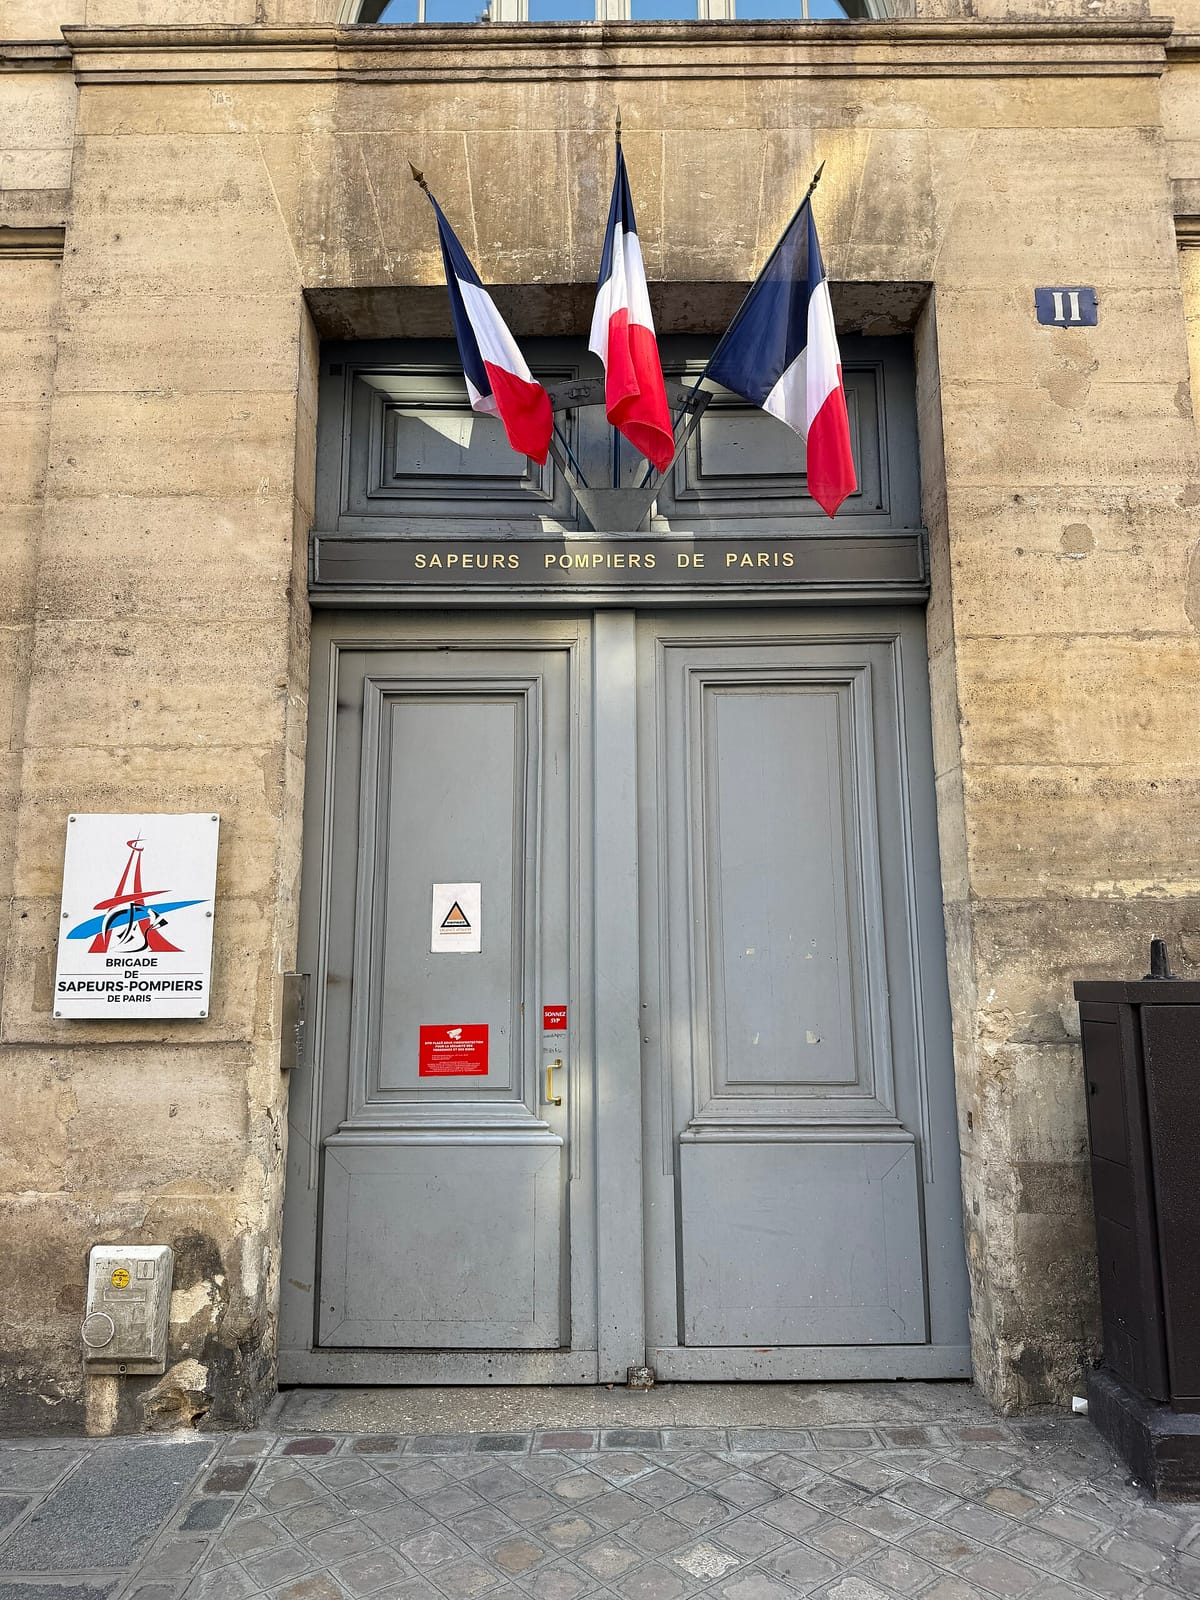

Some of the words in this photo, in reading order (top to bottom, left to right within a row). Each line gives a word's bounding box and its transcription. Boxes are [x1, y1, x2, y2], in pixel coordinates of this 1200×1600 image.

[1052, 292, 1081, 321] 11
[414, 553, 520, 569] SAPEURS
[544, 553, 656, 569] POMPIERS
[677, 553, 705, 568] DE
[725, 552, 795, 567] PARIS
[105, 958, 158, 968] BRIGADE
[124, 970, 139, 979] DE
[57, 980, 203, 992] SAPEURS-POMPIERS
[107, 995, 121, 1003] DE
[122, 994, 152, 1003] PARIS
